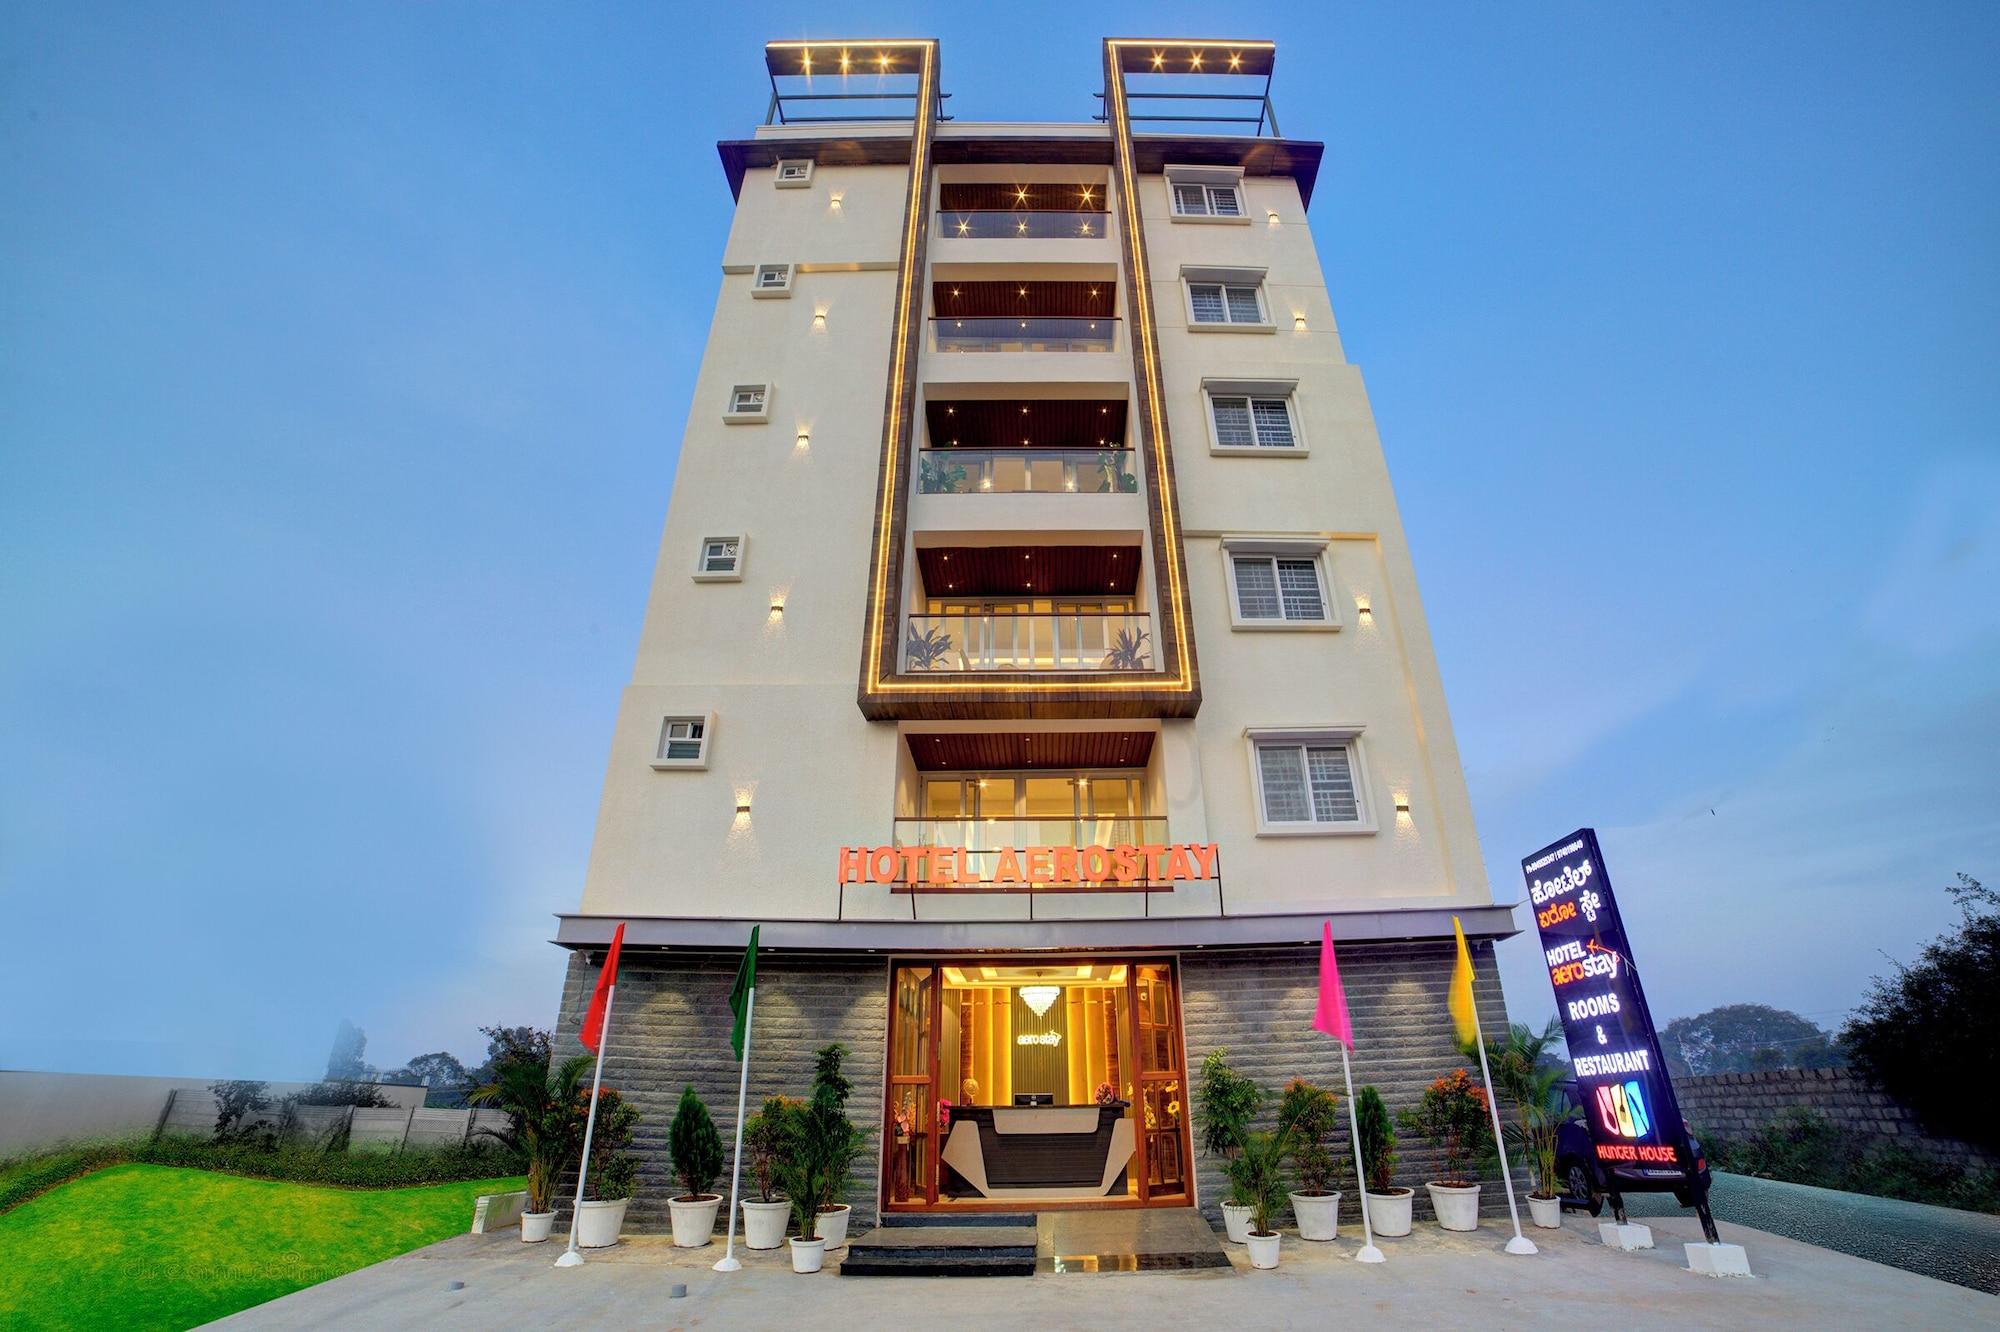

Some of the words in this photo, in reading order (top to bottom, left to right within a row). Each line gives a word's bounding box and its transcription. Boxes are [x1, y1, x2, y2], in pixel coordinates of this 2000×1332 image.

[838, 845, 981, 885] HOTEL
[993, 843, 1218, 883] AEROSTAY
[1531, 859, 1592, 904] ಹೋಟೆಲ್
[1546, 940, 1587, 967] HOTEL
[1568, 993, 1620, 1020] ROOMS
[1595, 1025, 1607, 1045] &
[1574, 1049, 1650, 1077] RESTAURANT
[1597, 1145, 1638, 1160] HUNGER
[1638, 1146, 1677, 1162] HOUSE
